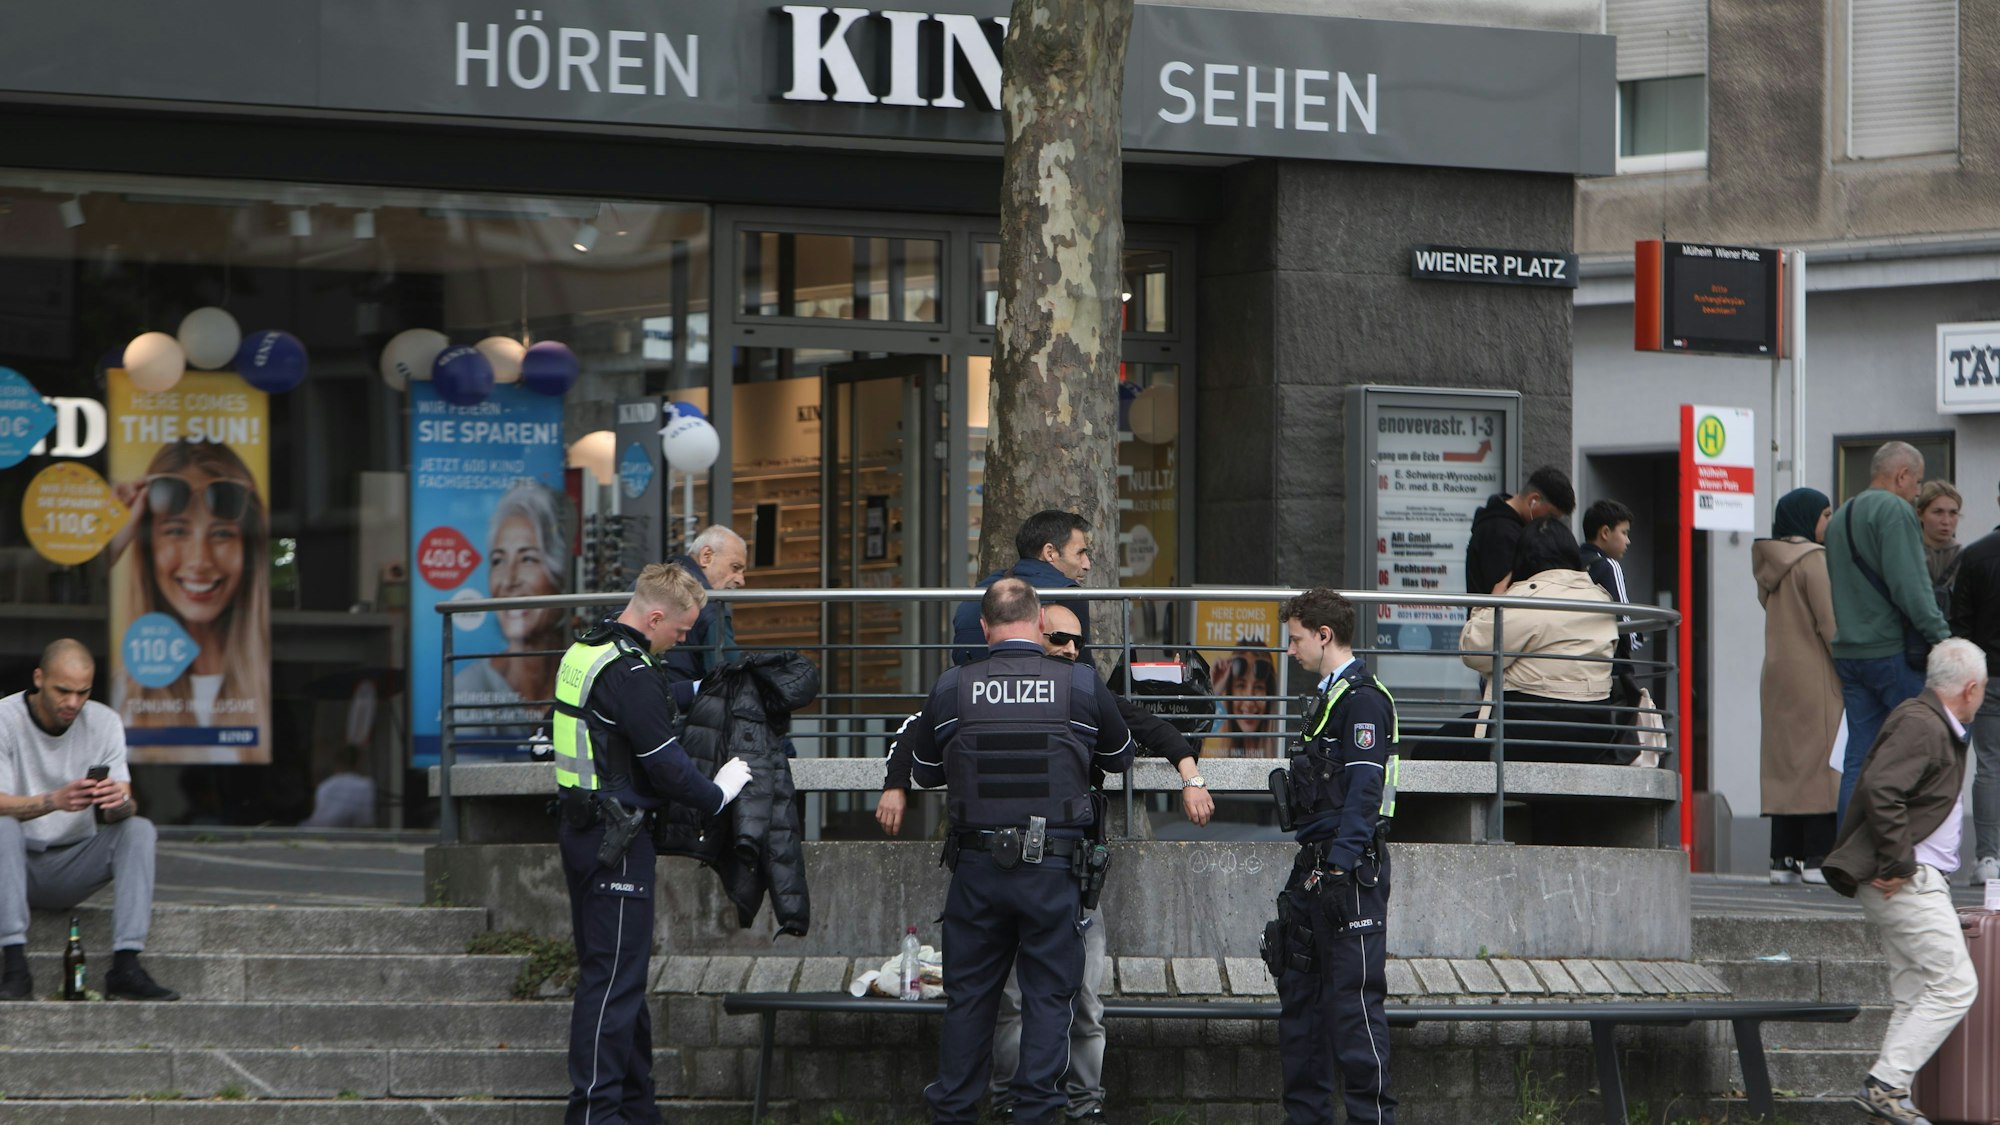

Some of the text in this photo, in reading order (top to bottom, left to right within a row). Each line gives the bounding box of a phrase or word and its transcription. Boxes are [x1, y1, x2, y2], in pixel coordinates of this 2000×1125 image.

[455, 9, 699, 98] HÖREN
[781, 5, 1004, 109] KIN
[1157, 60, 1378, 135] SEHEN
[1681, 244, 1761, 262] Mülheim Wiener Platz
[1415, 250, 1567, 281] WIENER PLATZ
[130, 393, 249, 413] HERE COMES
[417, 400, 447, 414] WIR
[618, 402, 658, 424] KIND
[797, 406, 822, 421] KIN
[119, 415, 262, 445] THE SUN!
[418, 420, 559, 445] SIE SPAREN!
[1378, 415, 1495, 438] enovevastr. 1-3
[1397, 453, 1409, 462] um
[1410, 451, 1421, 462] die
[1422, 451, 1440, 462] Ecke
[1394, 469, 1403, 479] E.
[1394, 481, 1478, 494] Dr. med. B. Rackow
[1408, 532, 1432, 543] GmbH
[422, 549, 472, 568] 400 €
[1393, 563, 1448, 575] Rechtsanwalt
[1421, 578, 1439, 589] Uyar
[1211, 607, 1266, 621] HERE COMES
[1205, 622, 1271, 643] THE SUN!
[1377, 635, 1392, 645] OG
[129, 637, 187, 663] 110 €
[560, 662, 584, 689] POLIZEI
[971, 680, 1055, 704] POLIZEI
[610, 882, 635, 892] POLIZEI
[1348, 918, 1374, 930] POLIZEI
